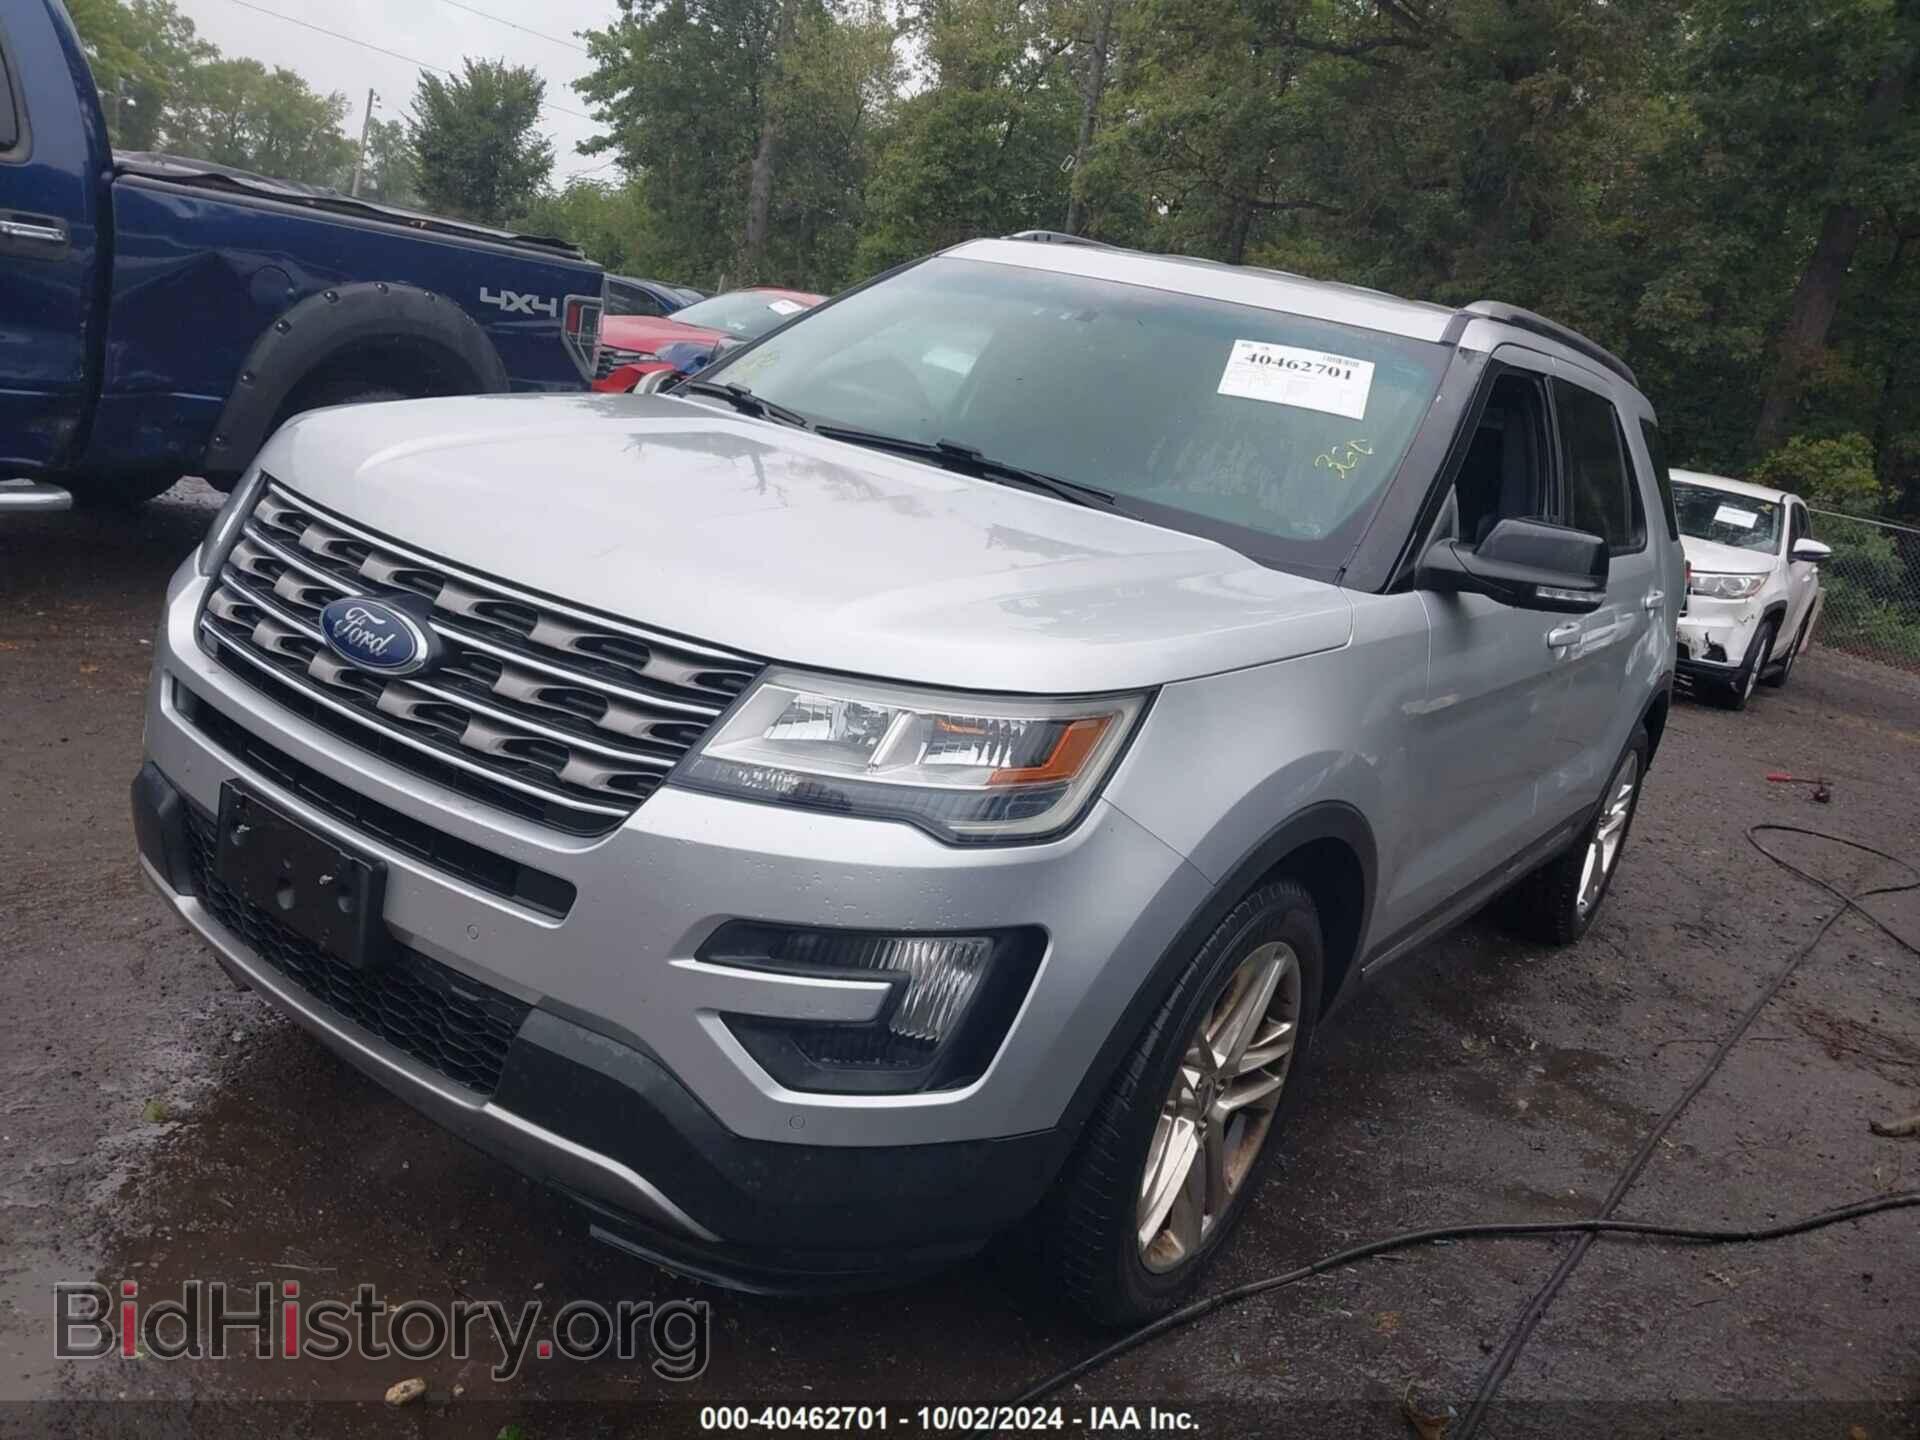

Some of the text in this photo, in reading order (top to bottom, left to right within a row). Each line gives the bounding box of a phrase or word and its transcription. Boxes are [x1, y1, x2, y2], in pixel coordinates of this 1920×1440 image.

[480, 287, 558, 318] 4X4
[1245, 353, 1352, 381] 40462701
[333, 607, 397, 657] Ford
